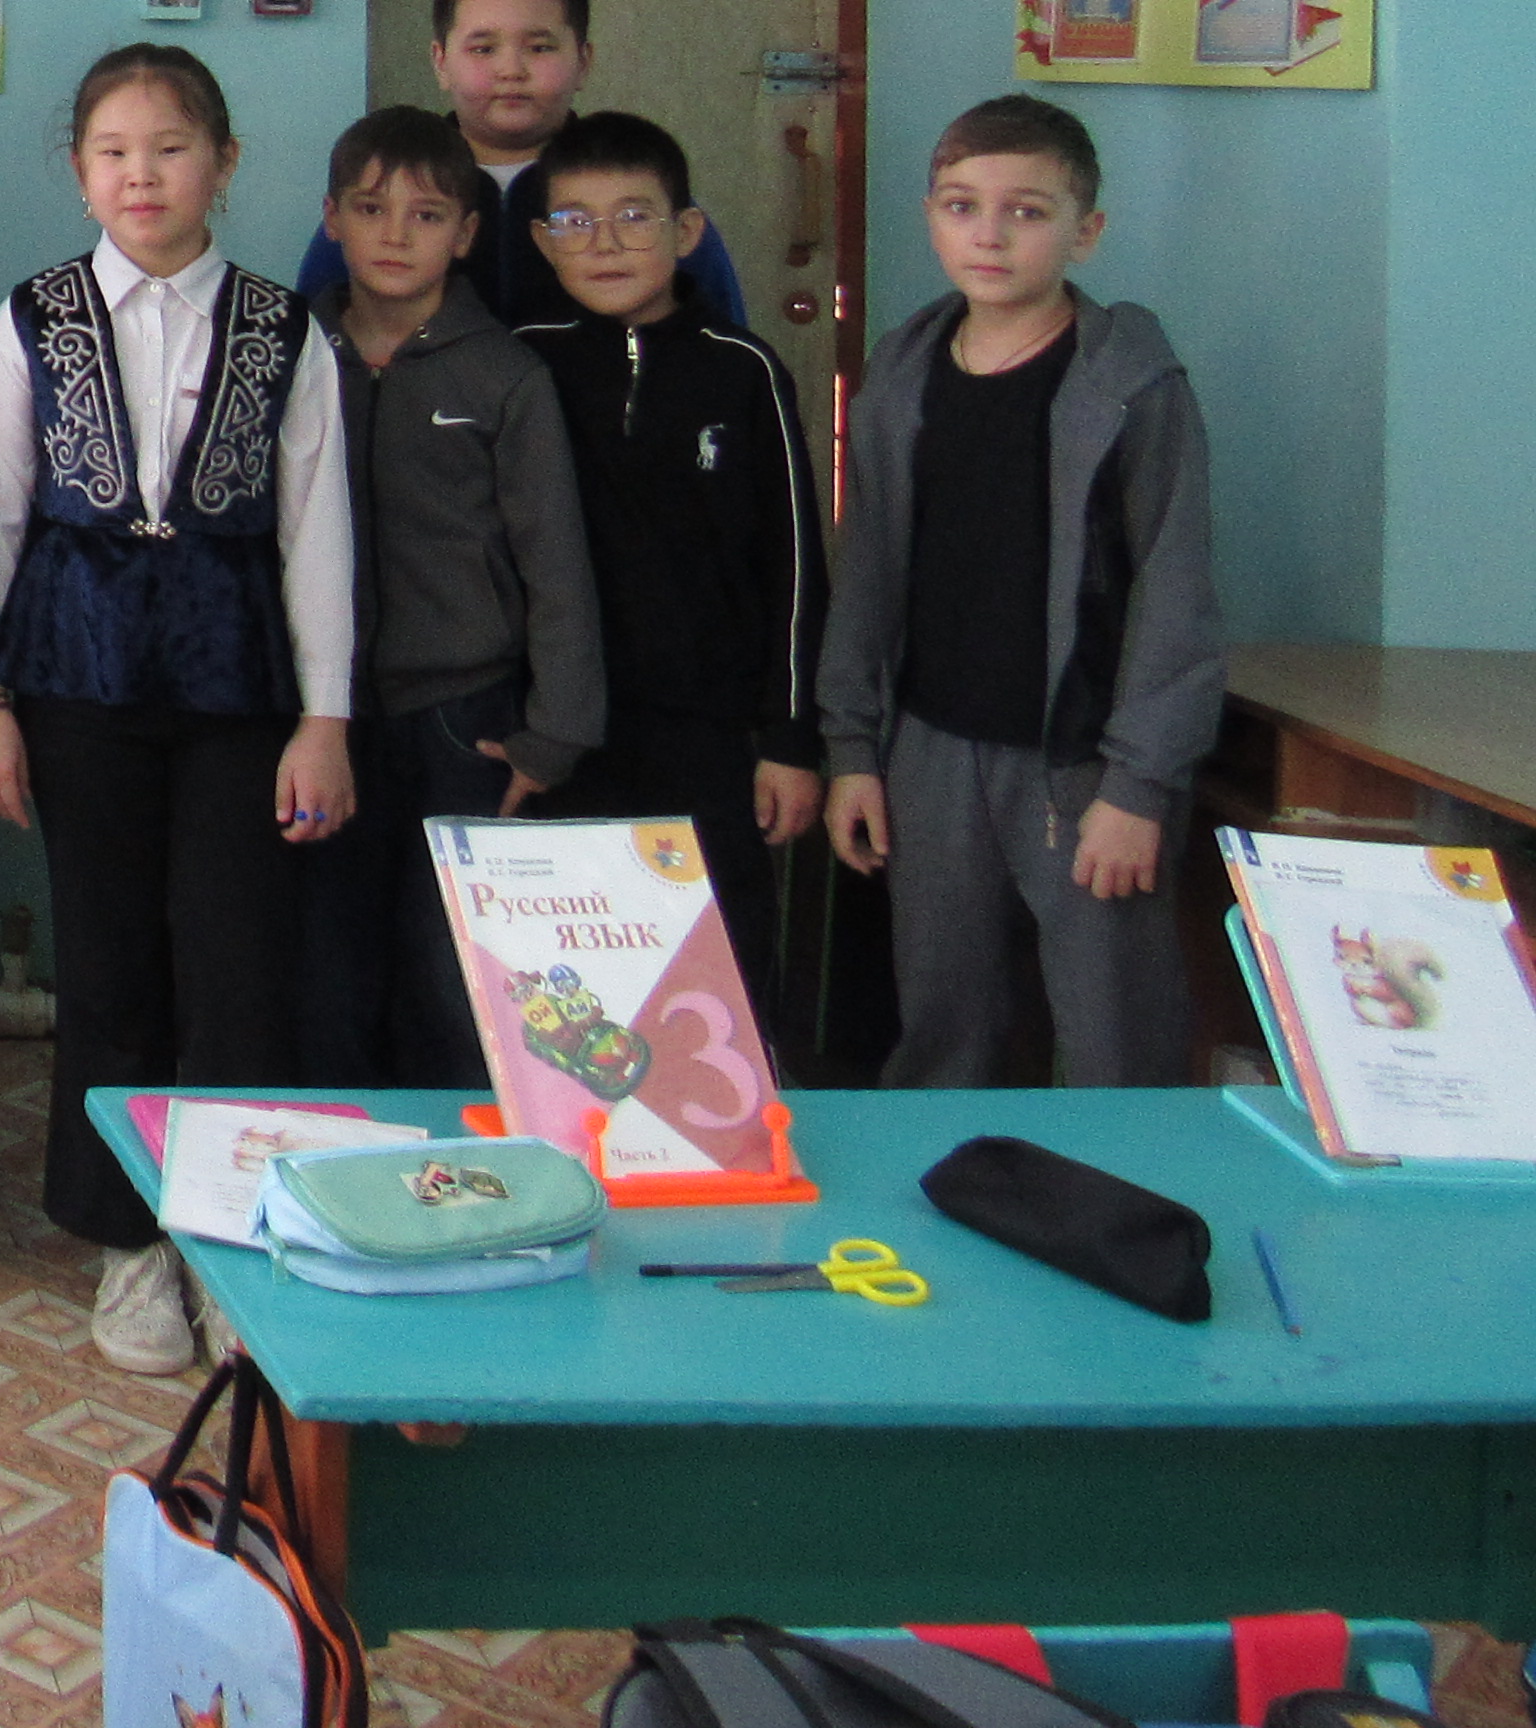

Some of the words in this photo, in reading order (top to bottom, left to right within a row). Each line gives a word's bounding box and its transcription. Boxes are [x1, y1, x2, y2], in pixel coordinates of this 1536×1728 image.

[467, 883, 612, 923] Русский
[658, 990, 759, 1130] 3
[611, 1149, 656, 1160] Часть
